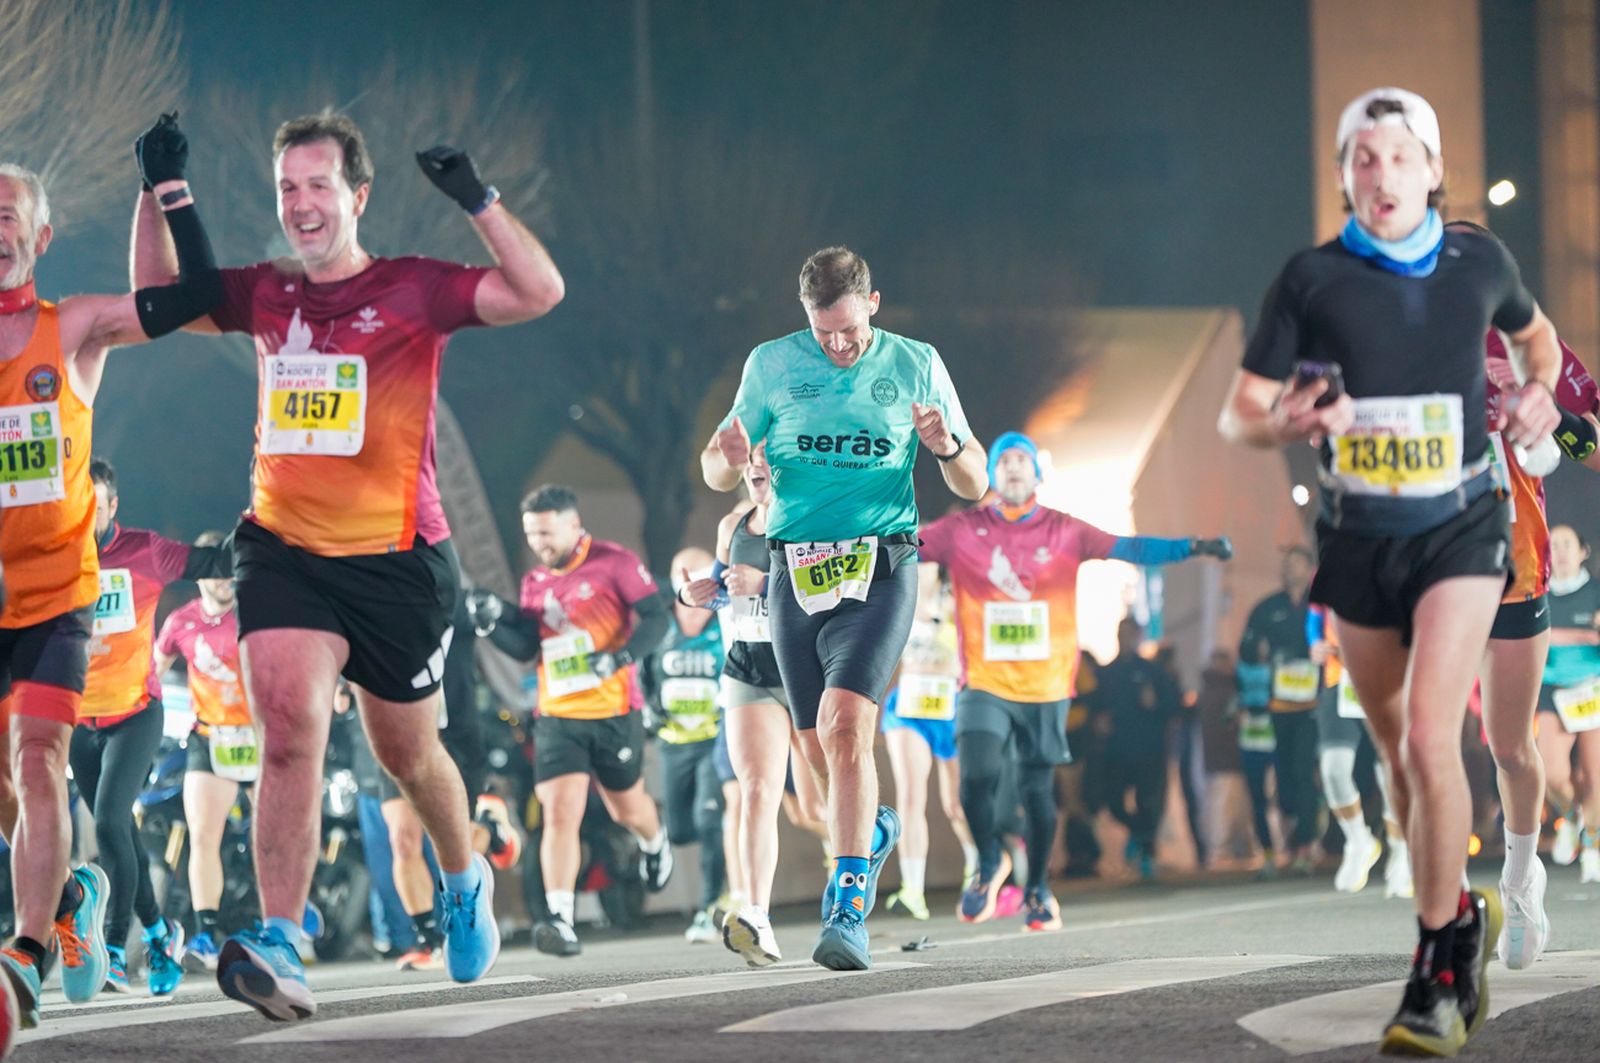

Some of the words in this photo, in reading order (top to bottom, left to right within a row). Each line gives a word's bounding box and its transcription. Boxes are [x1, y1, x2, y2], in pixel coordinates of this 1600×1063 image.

[284, 391, 341, 420] 4157
[797, 429, 892, 457] serás
[811, 458, 828, 466] QUE
[809, 554, 859, 586] 6152
